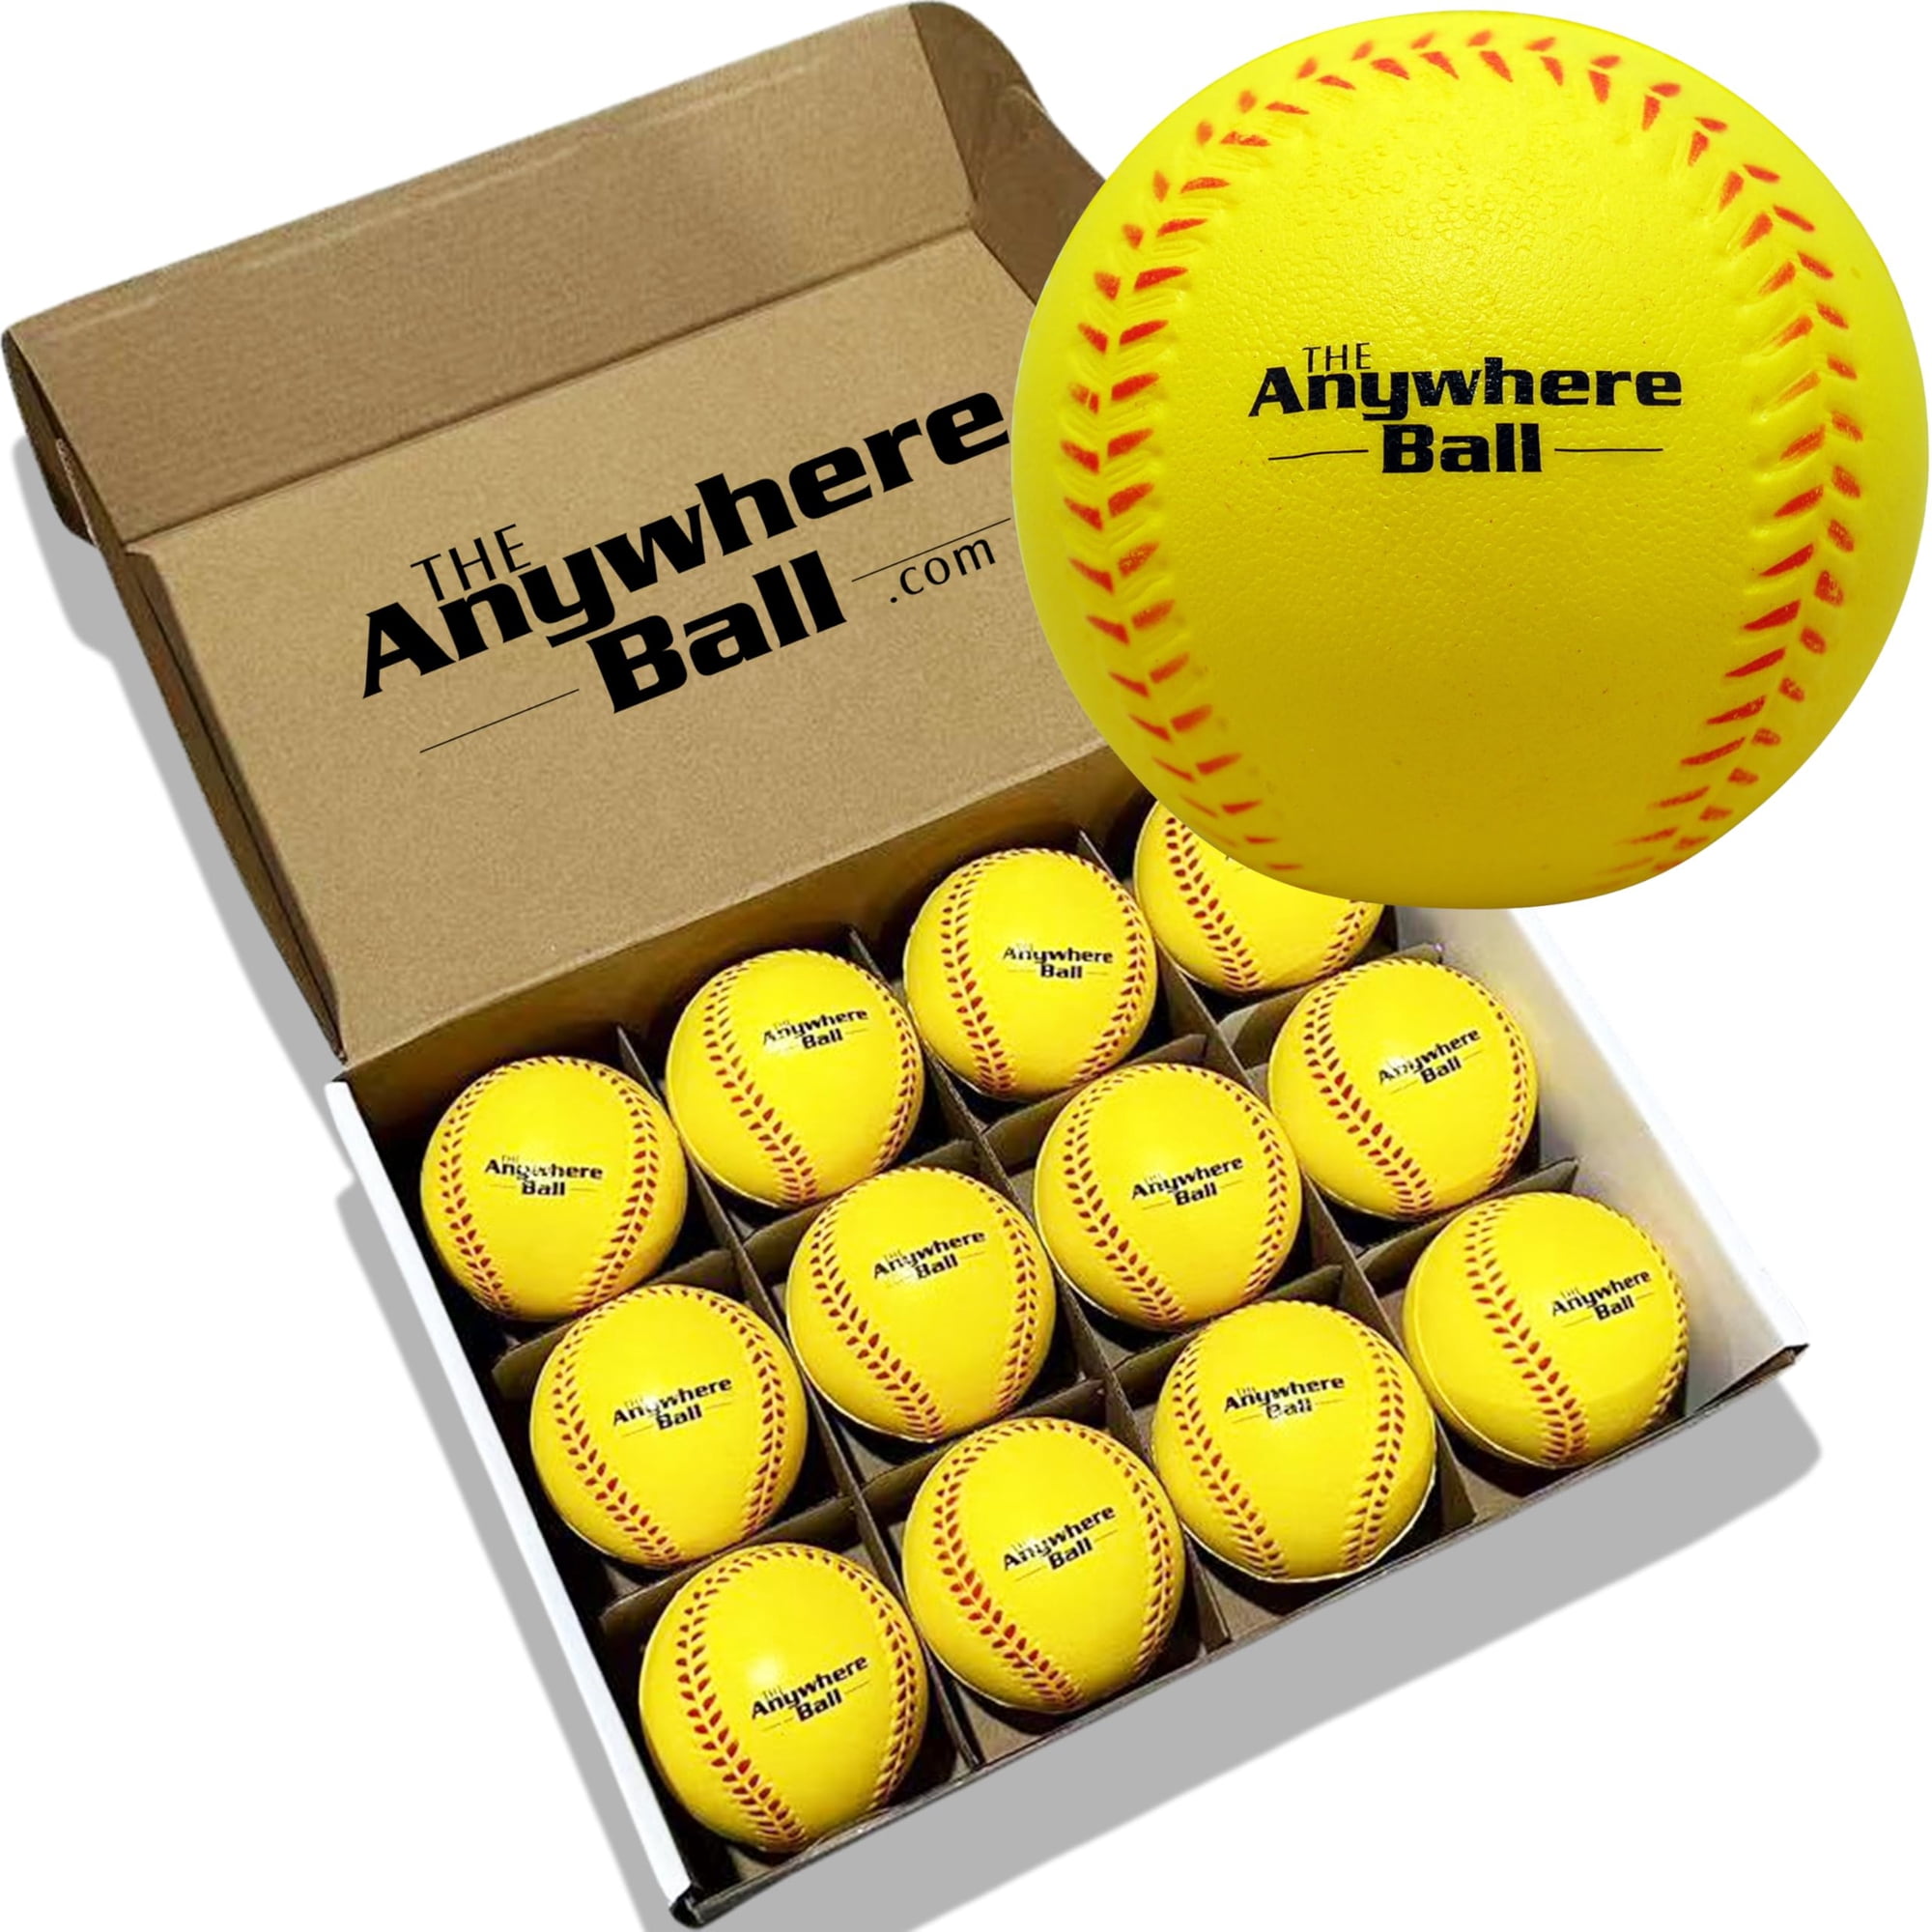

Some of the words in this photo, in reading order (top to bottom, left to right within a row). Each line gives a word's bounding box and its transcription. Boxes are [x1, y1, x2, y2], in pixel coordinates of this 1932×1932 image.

[1303, 343, 1371, 373] THE
[1248, 357, 1682, 421] Anywhere
[1382, 423, 1542, 473] Ball
[363, 392, 1009, 698] Anywhere
[411, 525, 531, 601] THE
[586, 551, 847, 713] Ball
[900, 539, 995, 595] .com
[1003, 948, 1113, 963] Anywhere
[1040, 964, 1082, 979] Ball
[762, 1009, 867, 1044] Anywhere
[803, 1028, 842, 1049] Ball
[1378, 1029, 1480, 1084] Anywhere
[1420, 1057, 1462, 1084] Ball
[485, 1158, 603, 1180] Anywhere
[1131, 1157, 1242, 1200] Anywhere
[521, 1181, 565, 1196] Ball
[1175, 1182, 1217, 1206] Ball
[873, 1232, 985, 1279] Anywhere
[917, 1253, 958, 1280] Ball
[1552, 1270, 1650, 1316] Anywhere
[1595, 1294, 1634, 1321] Ball
[612, 1378, 732, 1426] Anywhere
[1224, 1377, 1345, 1412] Anywhere
[656, 1404, 702, 1430] Ball
[1004, 1506, 1114, 1571] Anywhere
[1048, 1538, 1092, 1570] Ball
[752, 1656, 868, 1719] Anywhere
[795, 1689, 842, 1721] Ball
